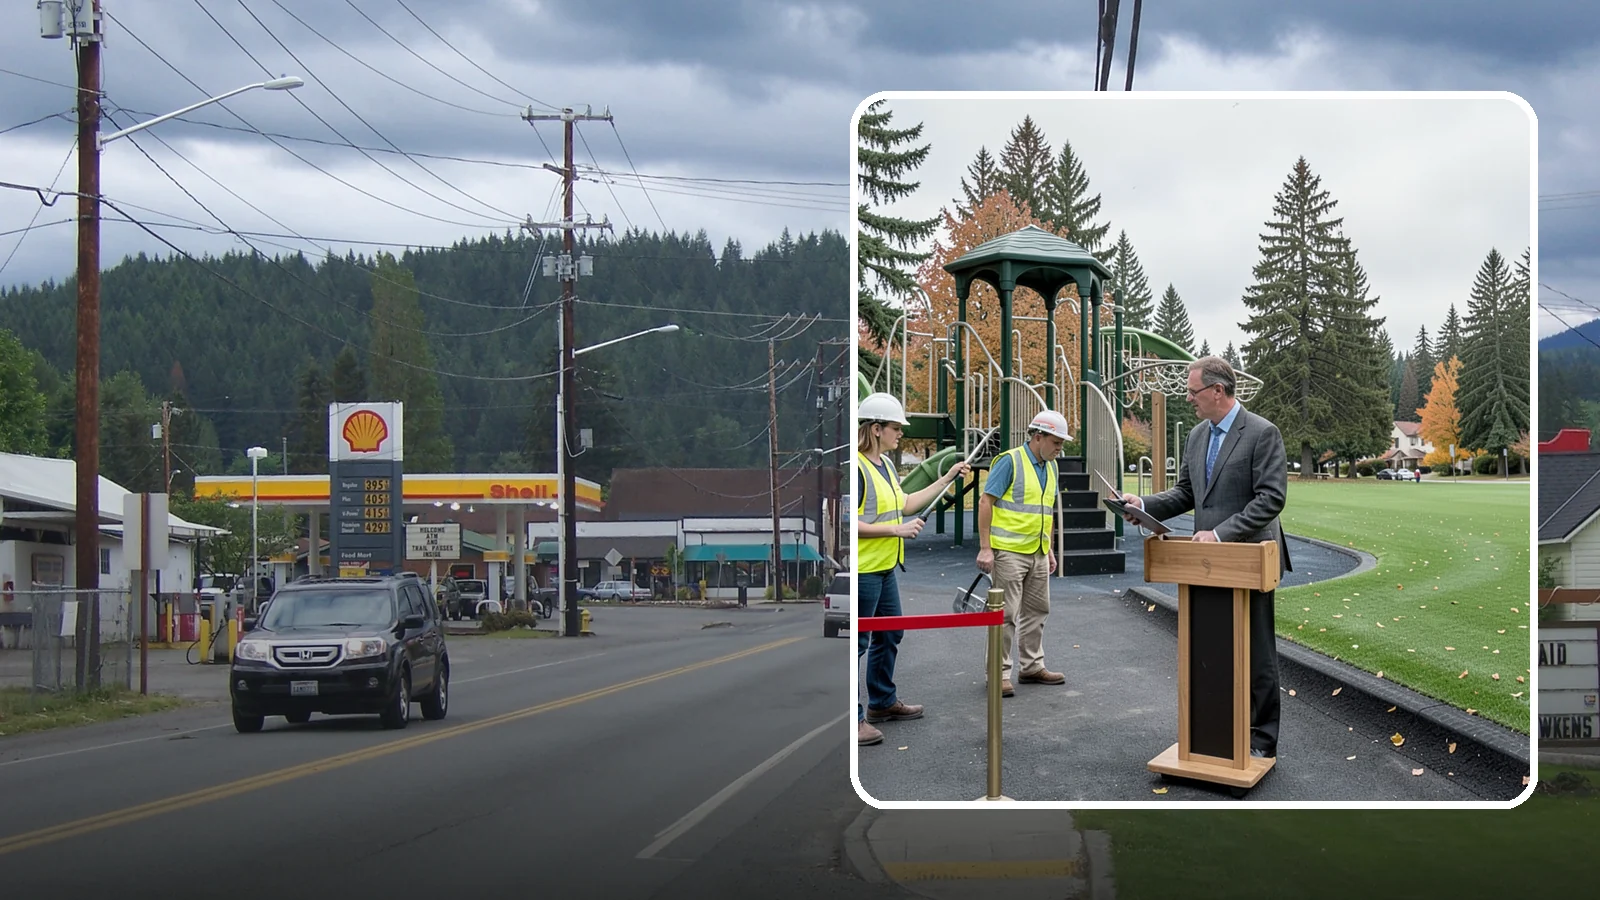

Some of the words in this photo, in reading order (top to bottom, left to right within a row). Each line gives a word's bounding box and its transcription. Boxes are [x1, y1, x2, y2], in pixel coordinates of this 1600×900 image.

[366, 480, 383, 490] 395
[490, 484, 547, 499] Shell
[366, 494, 383, 504] 405
[366, 508, 383, 518] 415
[366, 522, 383, 533] 429
[1539, 642, 1566, 666] AID
[1539, 715, 1592, 739] WKENS
